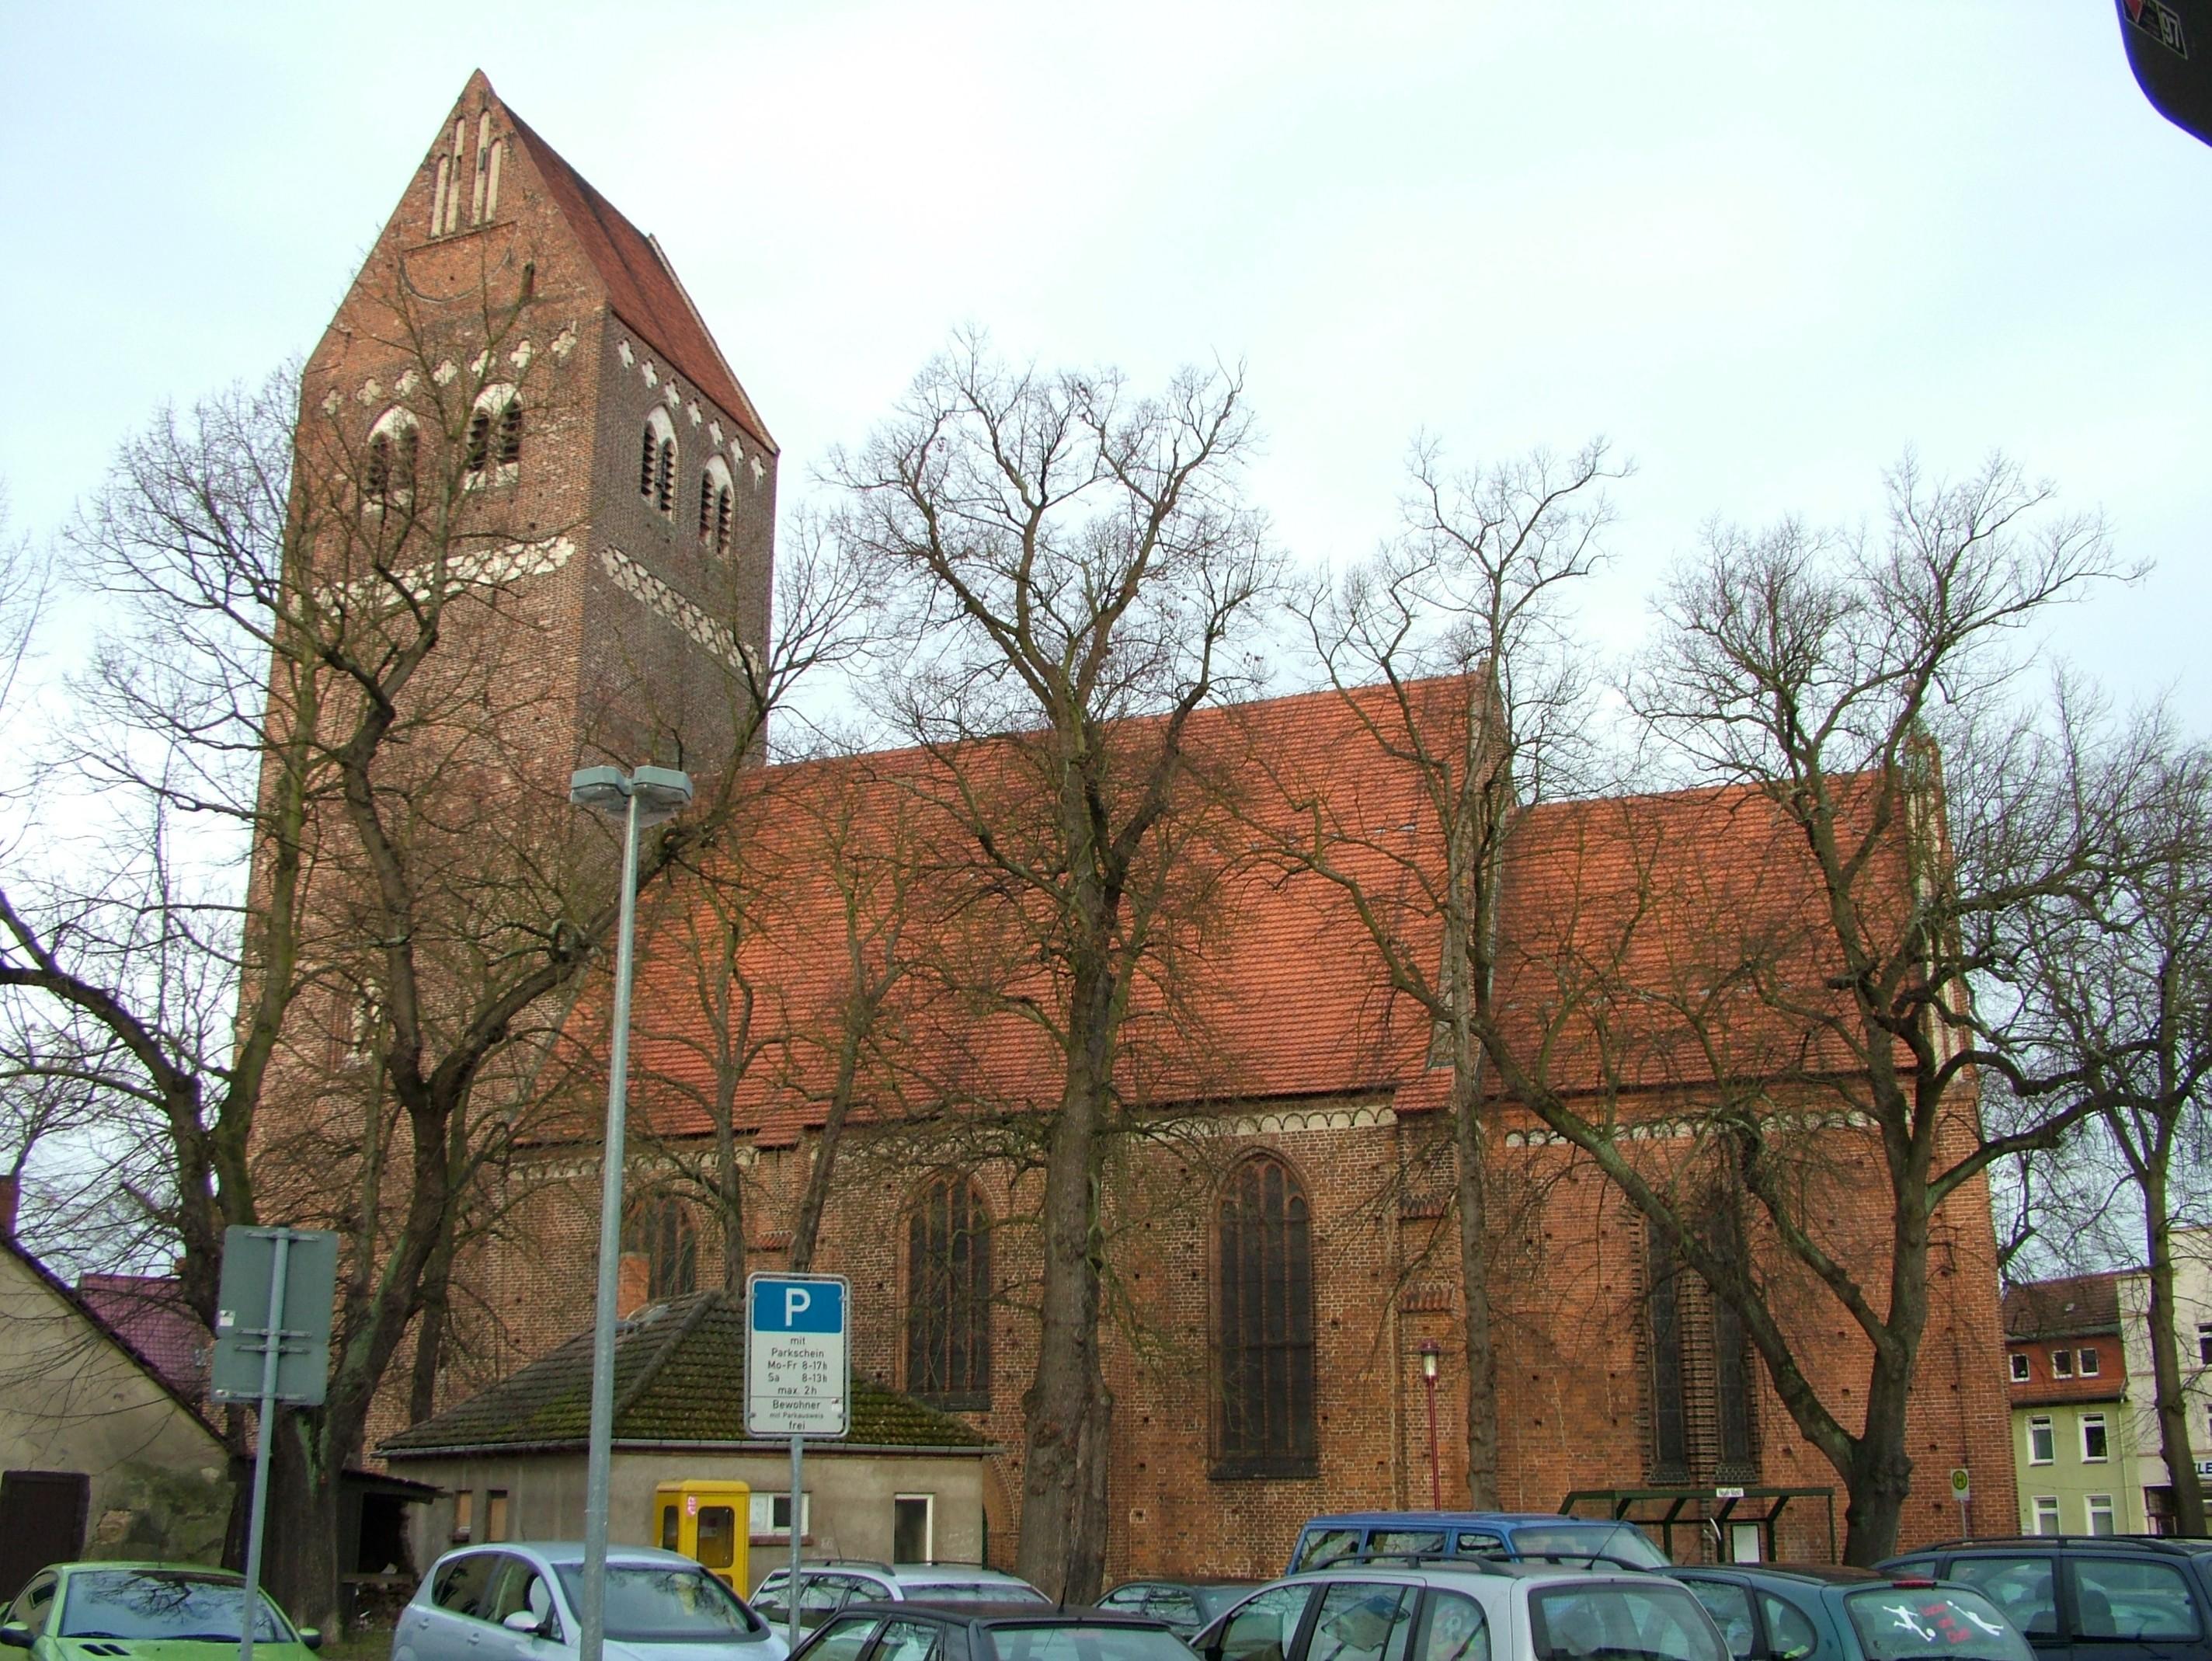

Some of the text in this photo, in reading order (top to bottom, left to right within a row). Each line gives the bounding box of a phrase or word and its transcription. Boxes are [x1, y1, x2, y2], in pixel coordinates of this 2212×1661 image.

[785, 1287, 811, 1327] P
[790, 1336, 805, 1346] mit
[771, 1347, 825, 1358] Parkschein
[767, 1360, 798, 1370] Mo-Fr
[767, 1372, 780, 1382] Sa
[773, 1399, 820, 1409] Bewohner
[788, 1420, 805, 1430] frei
